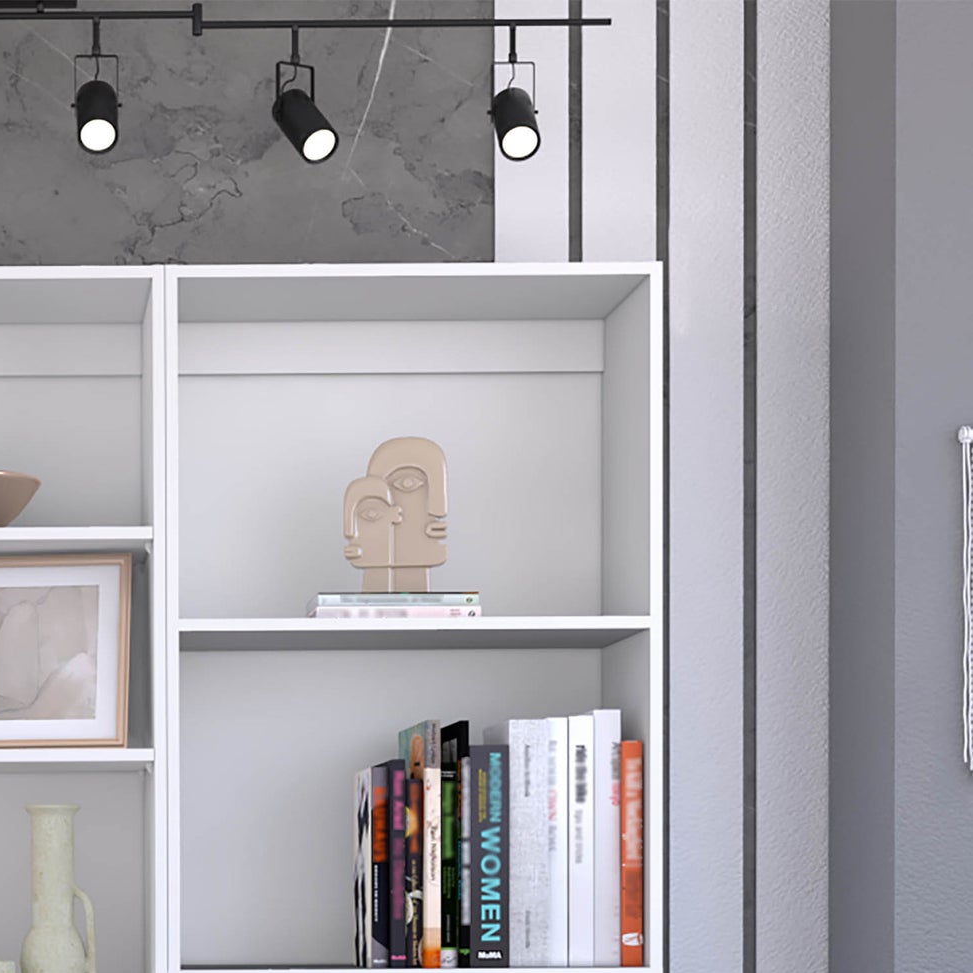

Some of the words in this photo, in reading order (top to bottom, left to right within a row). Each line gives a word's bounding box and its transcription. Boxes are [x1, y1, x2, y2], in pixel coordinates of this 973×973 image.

[489, 752, 501, 822] MODERN
[374, 786, 387, 862] BAUHAUS
[481, 827, 500, 941] WOMEN
[477, 951, 502, 959] MoMA
